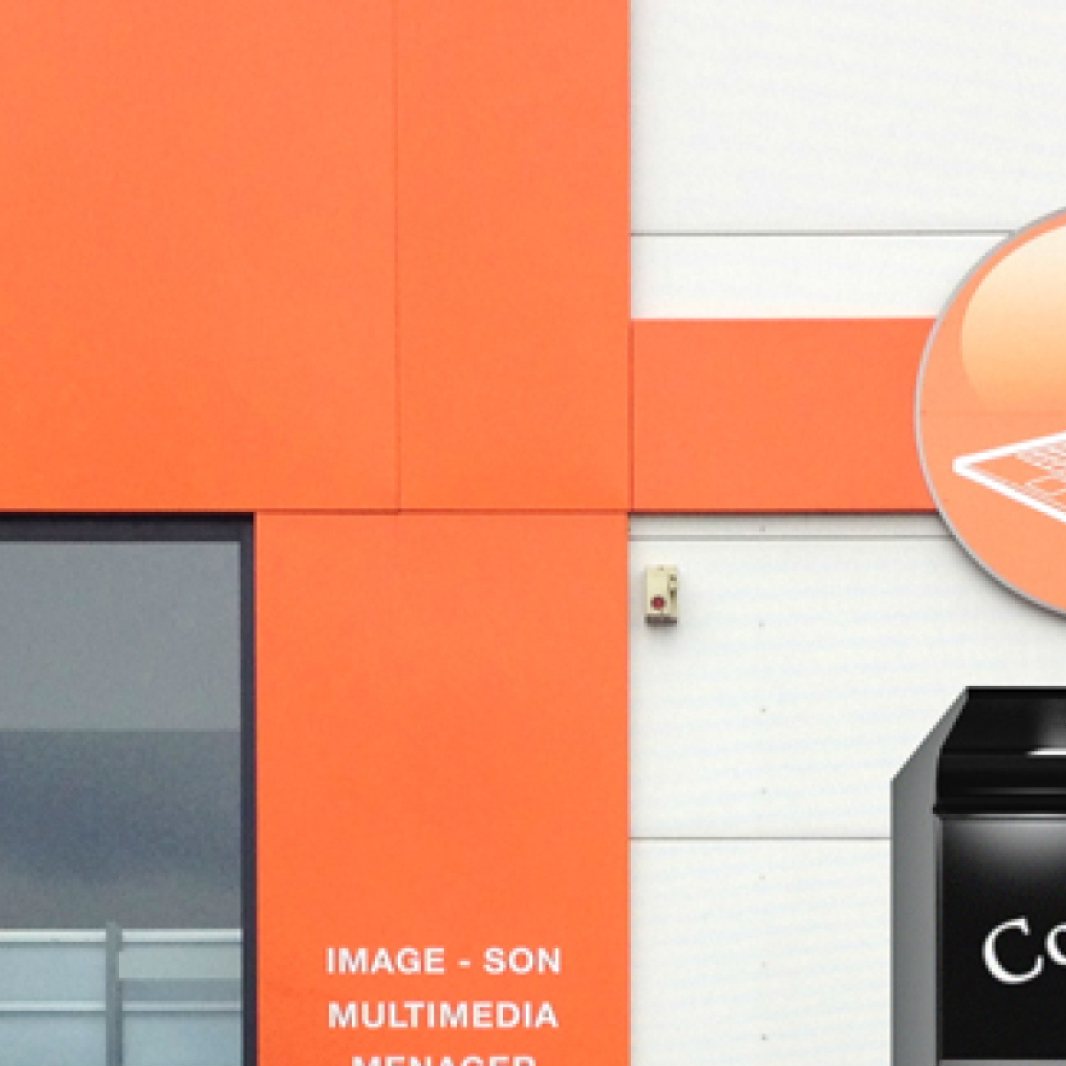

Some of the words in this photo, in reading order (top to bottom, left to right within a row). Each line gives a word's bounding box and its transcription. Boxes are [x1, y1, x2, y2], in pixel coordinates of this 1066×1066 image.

[326, 947, 446, 975] IMAGE
[483, 946, 562, 975] SON
[328, 1000, 559, 1029] MULTIMEDIA
